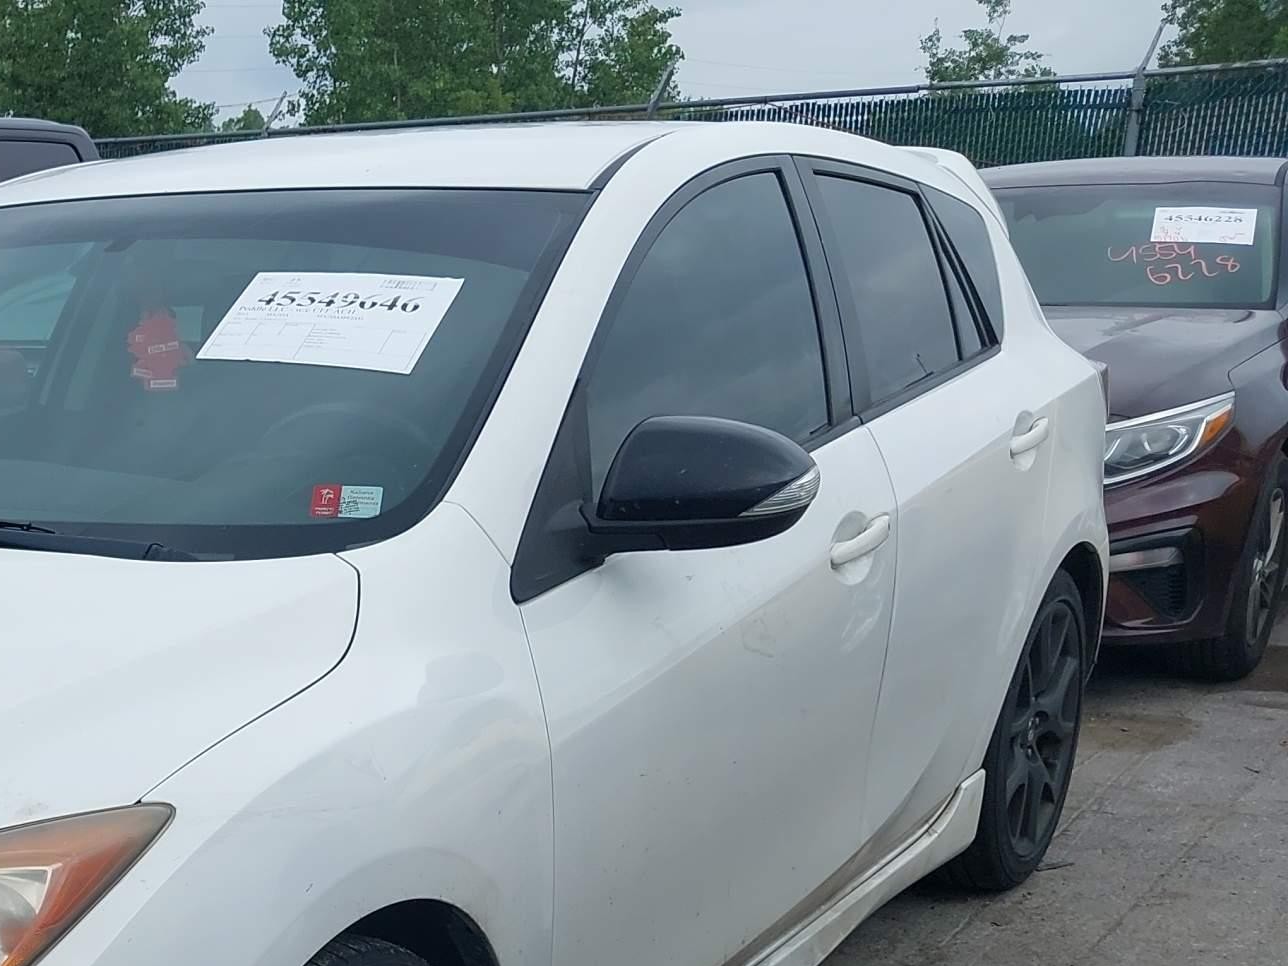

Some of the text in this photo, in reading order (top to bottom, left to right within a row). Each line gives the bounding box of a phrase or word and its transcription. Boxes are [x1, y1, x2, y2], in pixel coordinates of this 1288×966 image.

[1163, 214, 1243, 223] 45546228
[1107, 242, 1195, 264] 4554
[1147, 255, 1241, 285] 6228
[257, 291, 424, 313] 45549646
